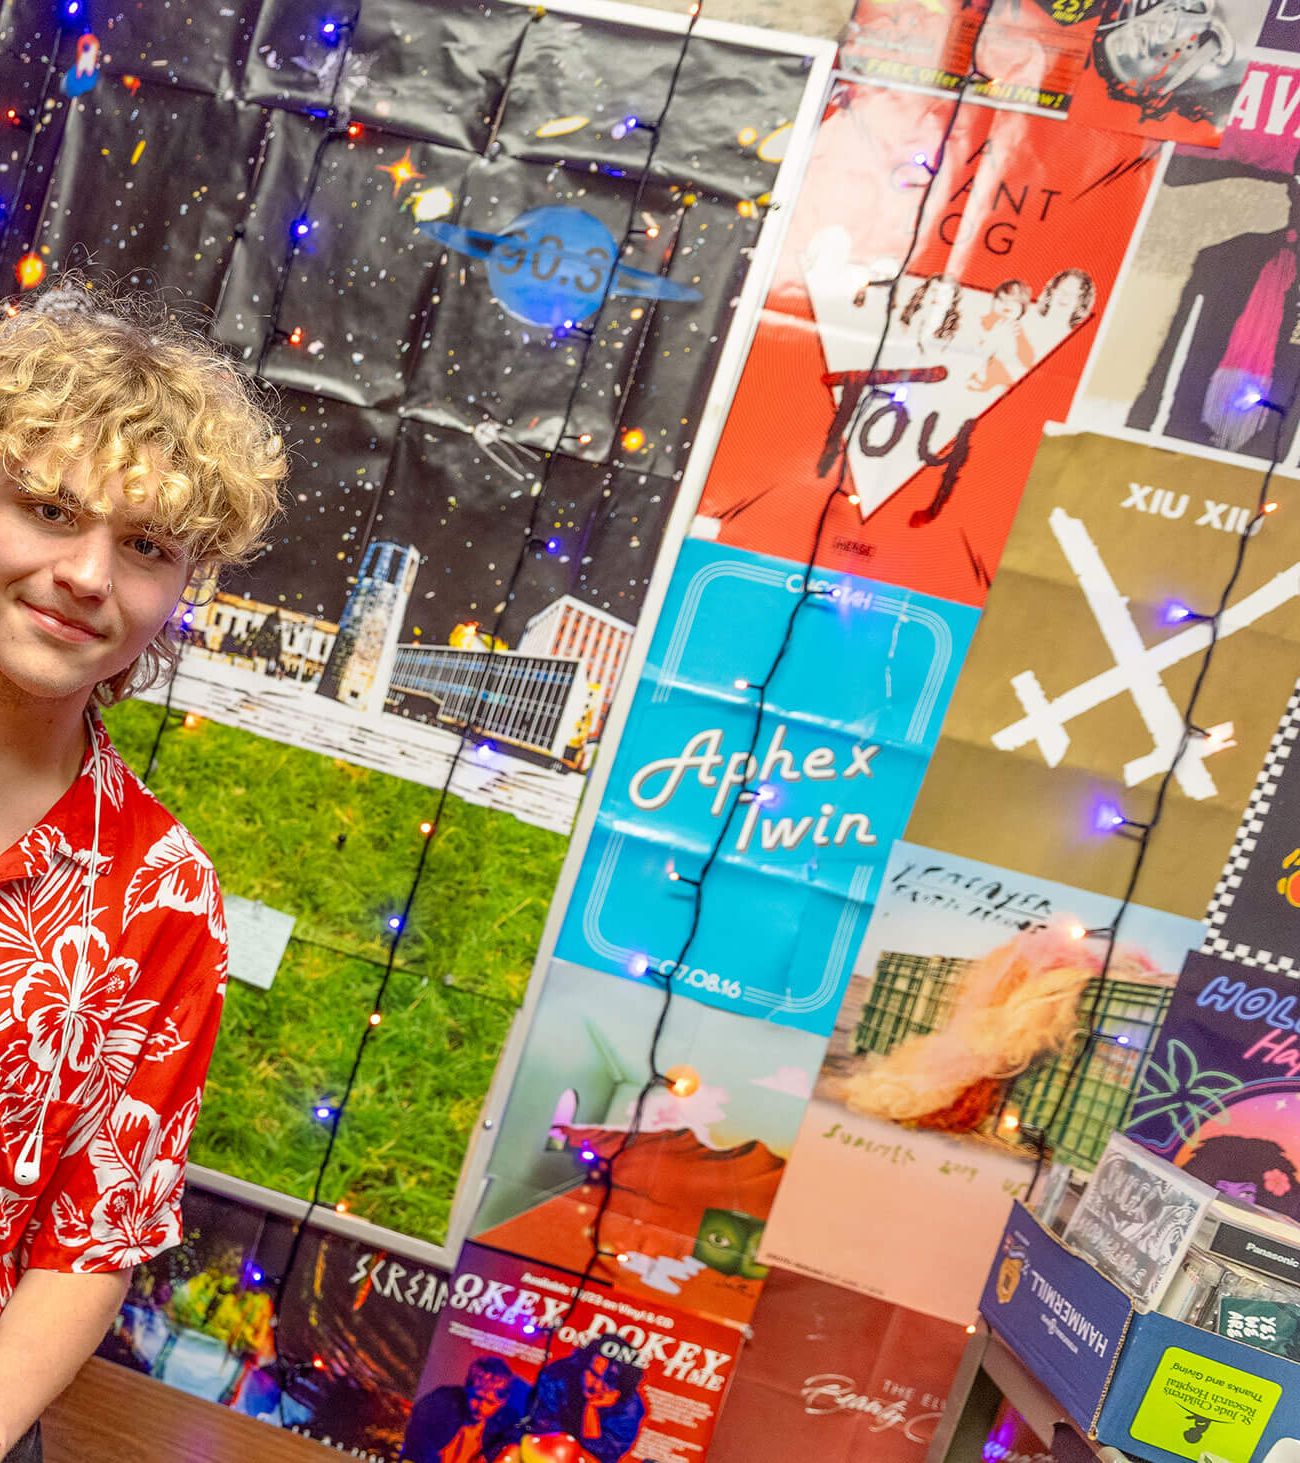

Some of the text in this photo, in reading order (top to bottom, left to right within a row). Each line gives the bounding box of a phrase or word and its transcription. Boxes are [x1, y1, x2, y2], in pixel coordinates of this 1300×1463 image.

[867, 57, 915, 80] FREE
[919, 68, 959, 88] Offer
[1014, 86, 1064, 109] Now!
[1227, 69, 1300, 138] AV
[497, 229, 609, 294] 90.3
[1121, 482, 1264, 536] XIU XIU
[628, 725, 882, 817] Aphex
[736, 790, 877, 854] Twin
[1245, 1242, 1300, 1268] Panasonic
[454, 1273, 571, 1327] OKEY
[1030, 1269, 1108, 1358] HAMMERMILL
[1226, 1310, 1245, 1338] ARE
[450, 1293, 517, 1326] ONCE
[663, 1358, 726, 1391] TIME
[586, 1313, 732, 1378] DOKEY
[1243, 1316, 1261, 1338] WE
[1259, 1316, 1277, 1342] YES
[1163, 1385, 1214, 1412] Children's
[1167, 1377, 1257, 1418] Research Hospital
[1172, 1361, 1263, 1403] Thanks and Giving
[1213, 1405, 1238, 1421] Jude
